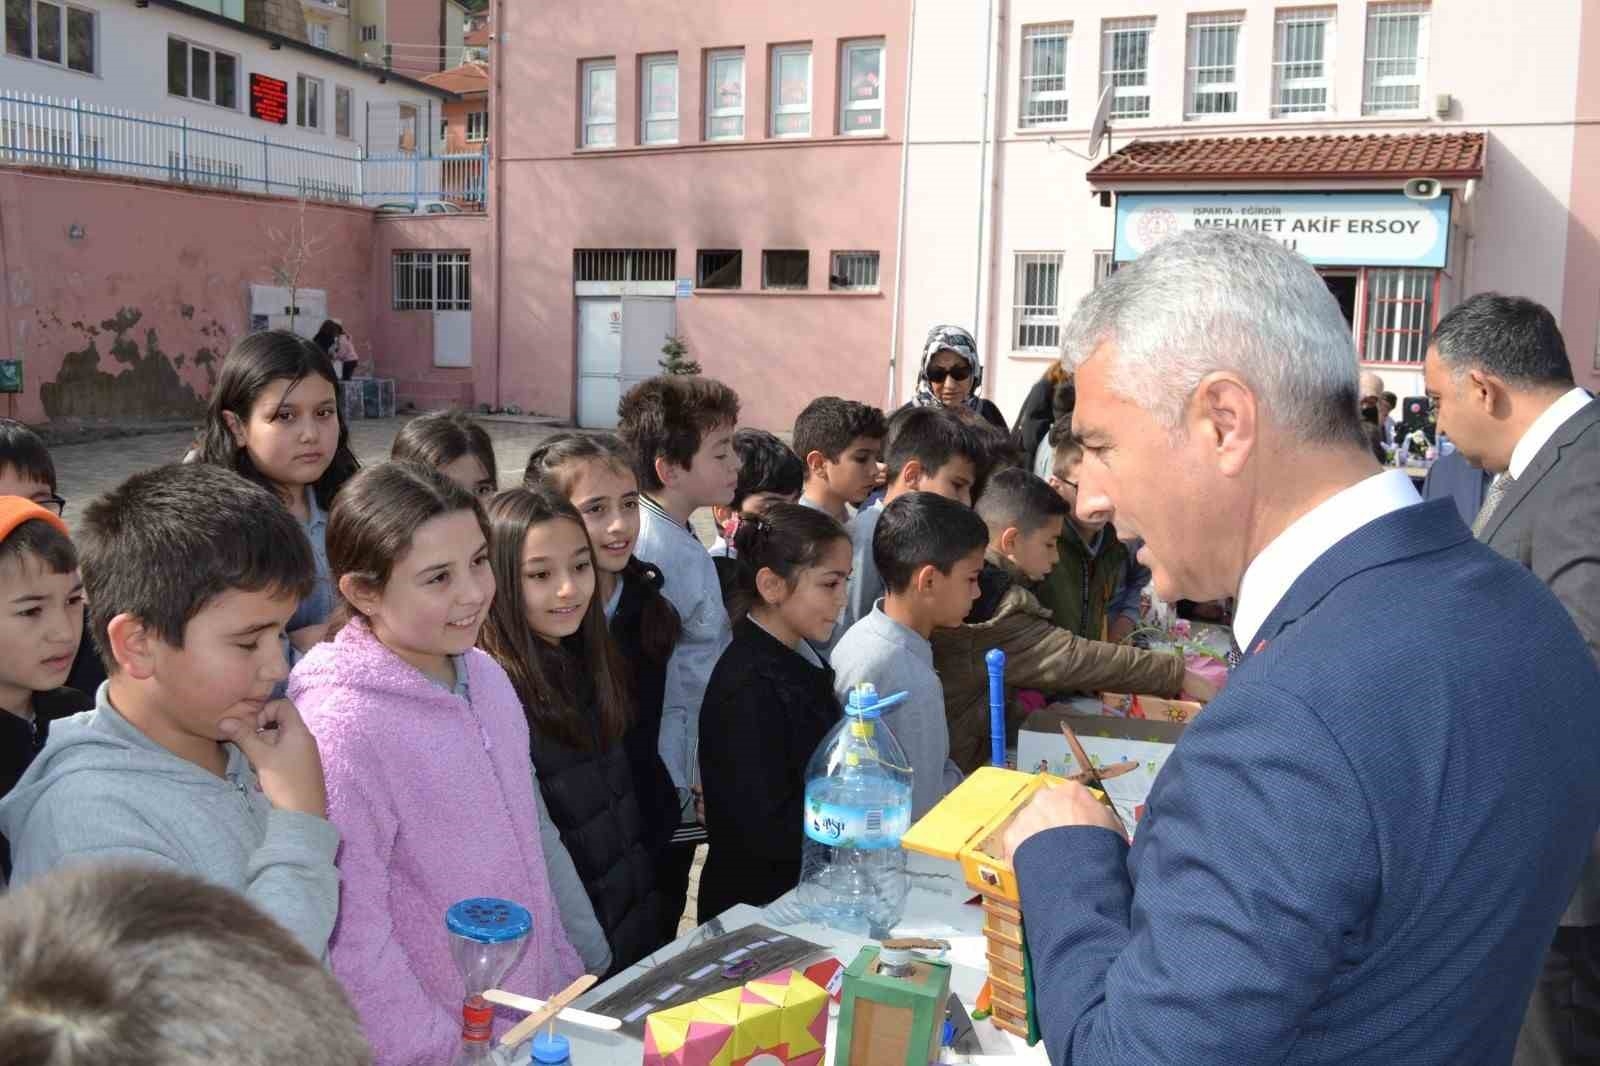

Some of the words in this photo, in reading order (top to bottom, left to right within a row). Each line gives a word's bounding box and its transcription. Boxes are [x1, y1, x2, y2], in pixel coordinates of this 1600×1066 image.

[1193, 207, 1233, 215] ISPARTA
[1194, 219, 1286, 232] MEHMET
[1292, 216, 1341, 233] AKİF
[1347, 219, 1421, 234] ERSOY
